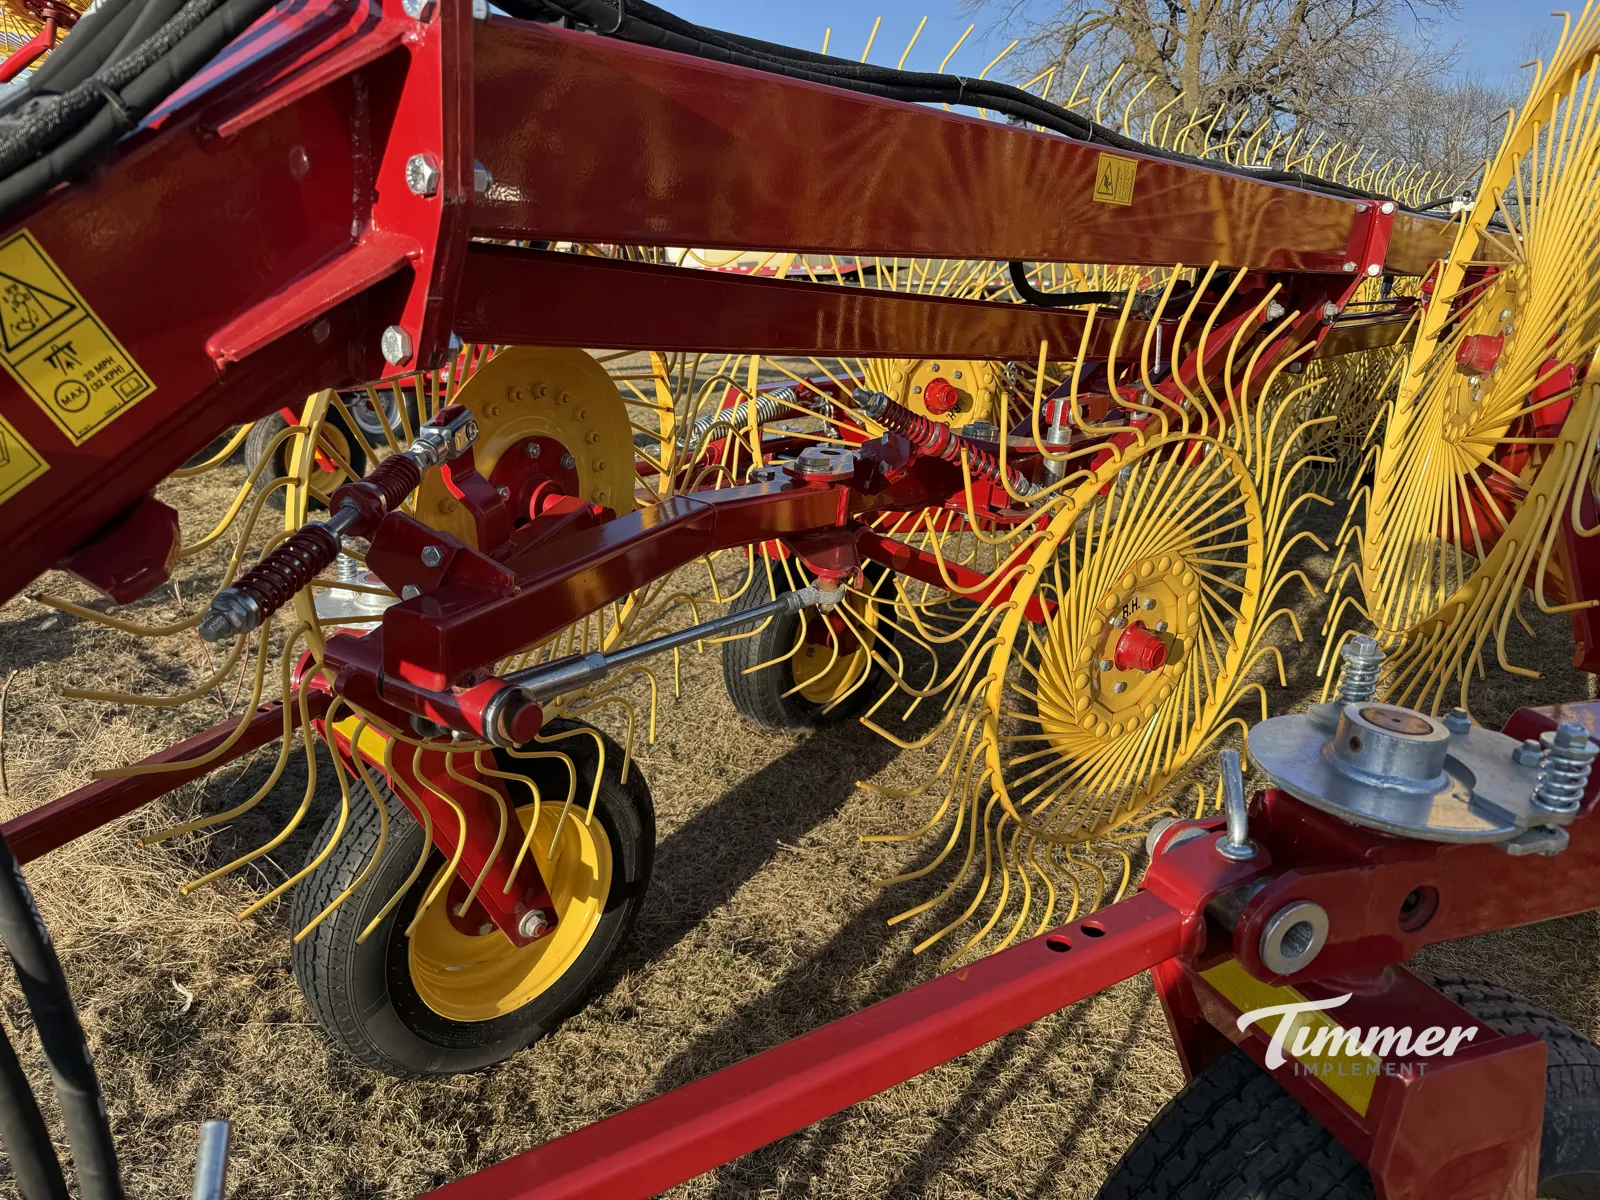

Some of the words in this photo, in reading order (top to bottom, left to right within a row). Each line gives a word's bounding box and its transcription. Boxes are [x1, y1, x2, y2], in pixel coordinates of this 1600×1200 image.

[83, 369, 95, 382] 20
[94, 355, 116, 374] MPH
[90, 379, 106, 393] (32
[103, 363, 126, 382] KPH)
[61, 386, 86, 406] MAX
[1122, 597, 1141, 619] R.H.
